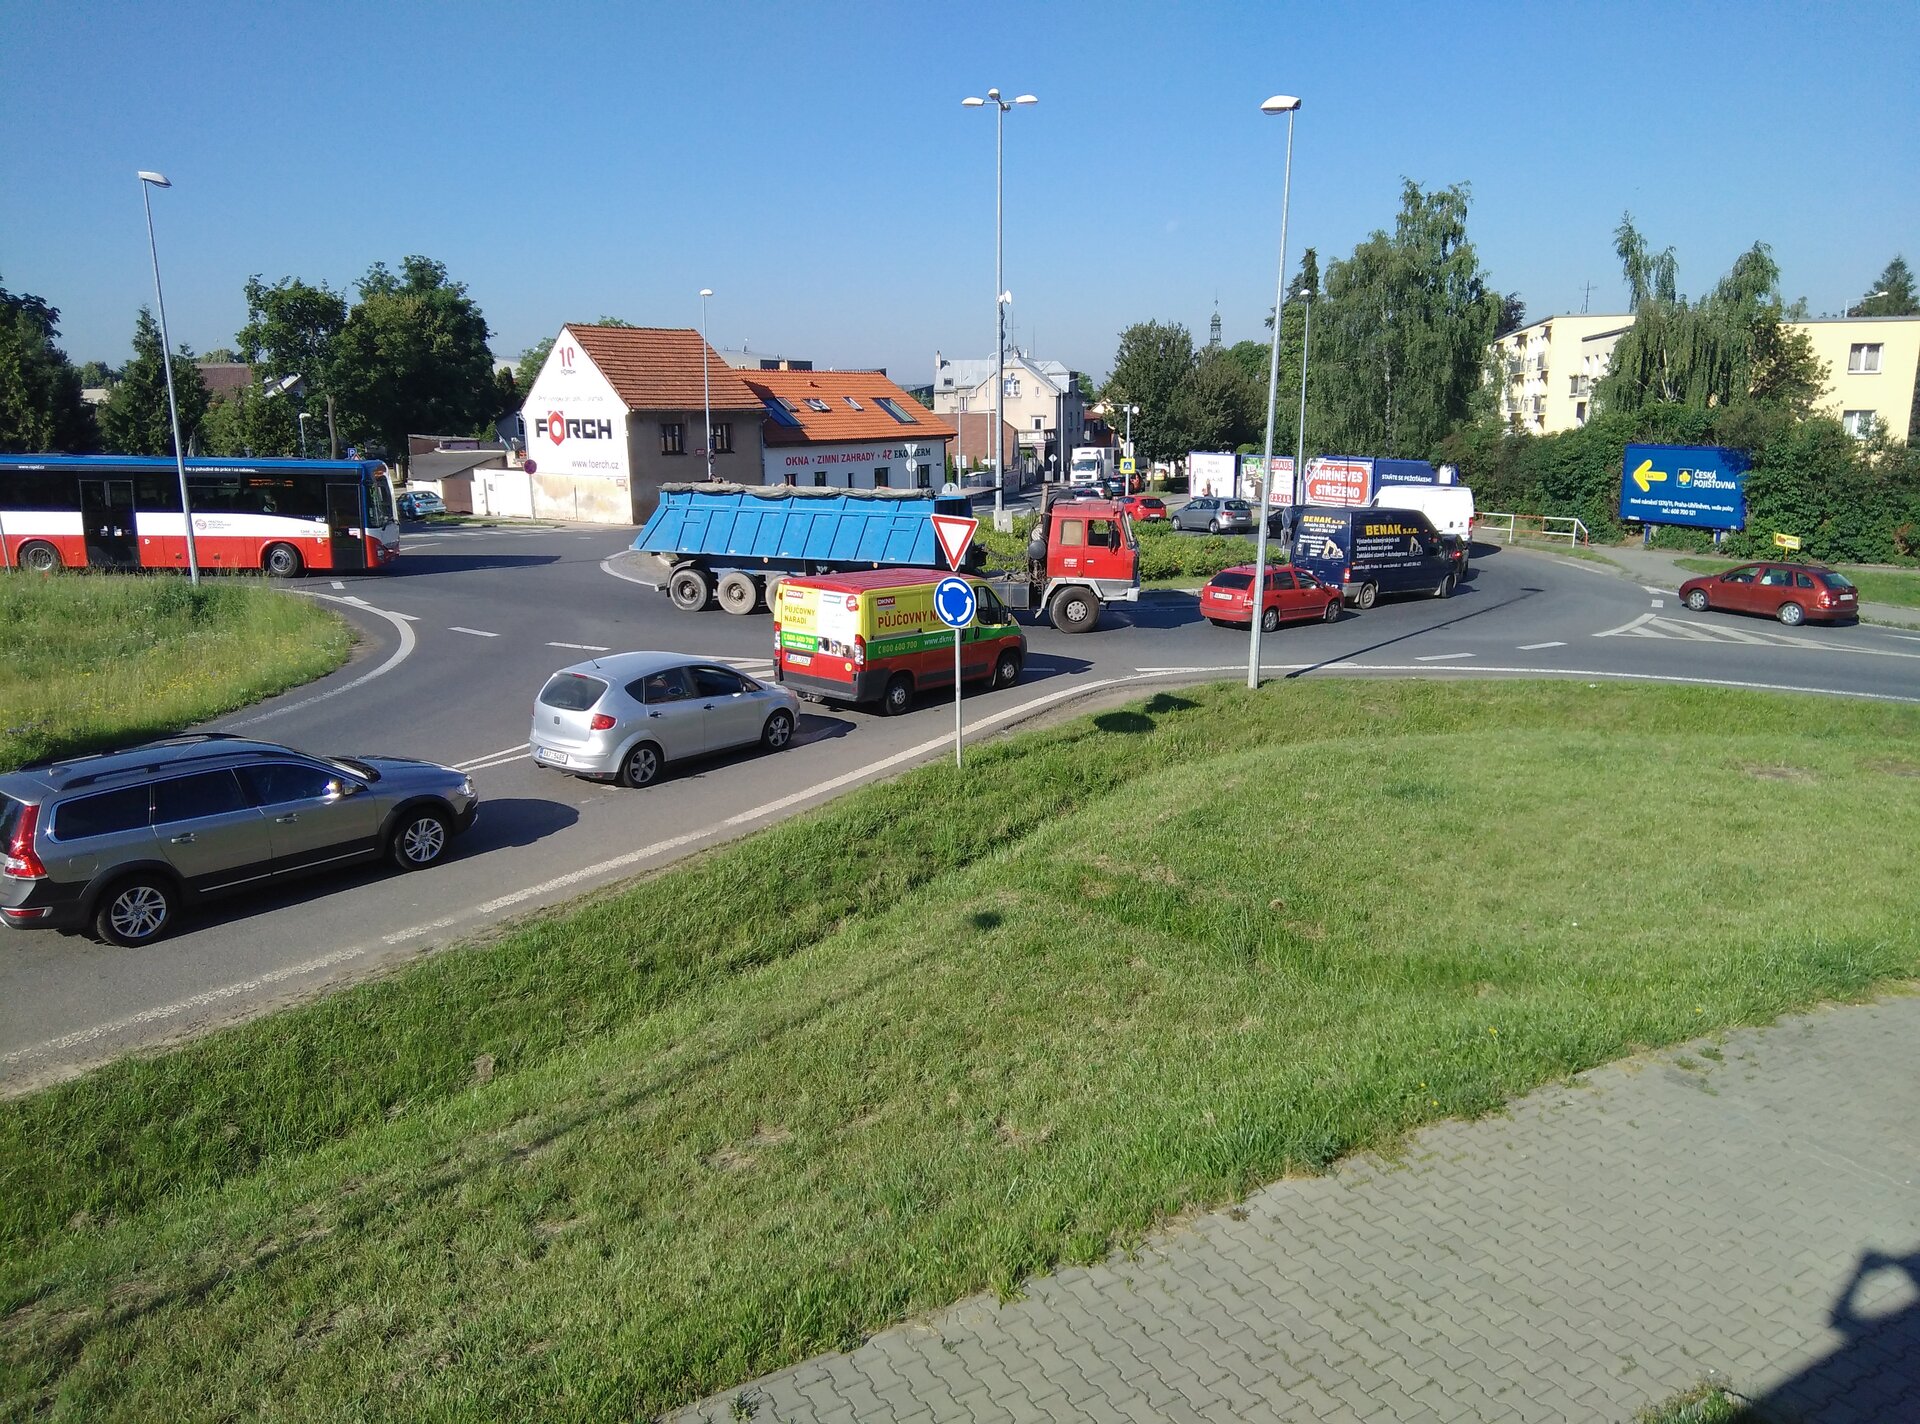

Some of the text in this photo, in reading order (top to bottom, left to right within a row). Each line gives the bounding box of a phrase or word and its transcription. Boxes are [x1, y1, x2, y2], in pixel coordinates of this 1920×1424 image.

[535, 411, 612, 446] FÖRCH
[785, 455, 809, 466] OKNA
[841, 452, 875, 463] ZAHRADY
[1271, 461, 1292, 470] UHAUS
[1694, 469, 1716, 480] ČESKÁ
[1315, 482, 1360, 498] STŘEŽENO
[1693, 479, 1736, 490] POJIŠŤOVNA
[1303, 515, 1332, 523] BENAK
[1365, 524, 1402, 536] BENAK
[786, 590, 804, 599] DKNV
[878, 610, 928, 628] PŮJČOVNY
[882, 644, 893, 653] 800
[894, 642, 906, 651] 600
[906, 640, 918, 649] 700
